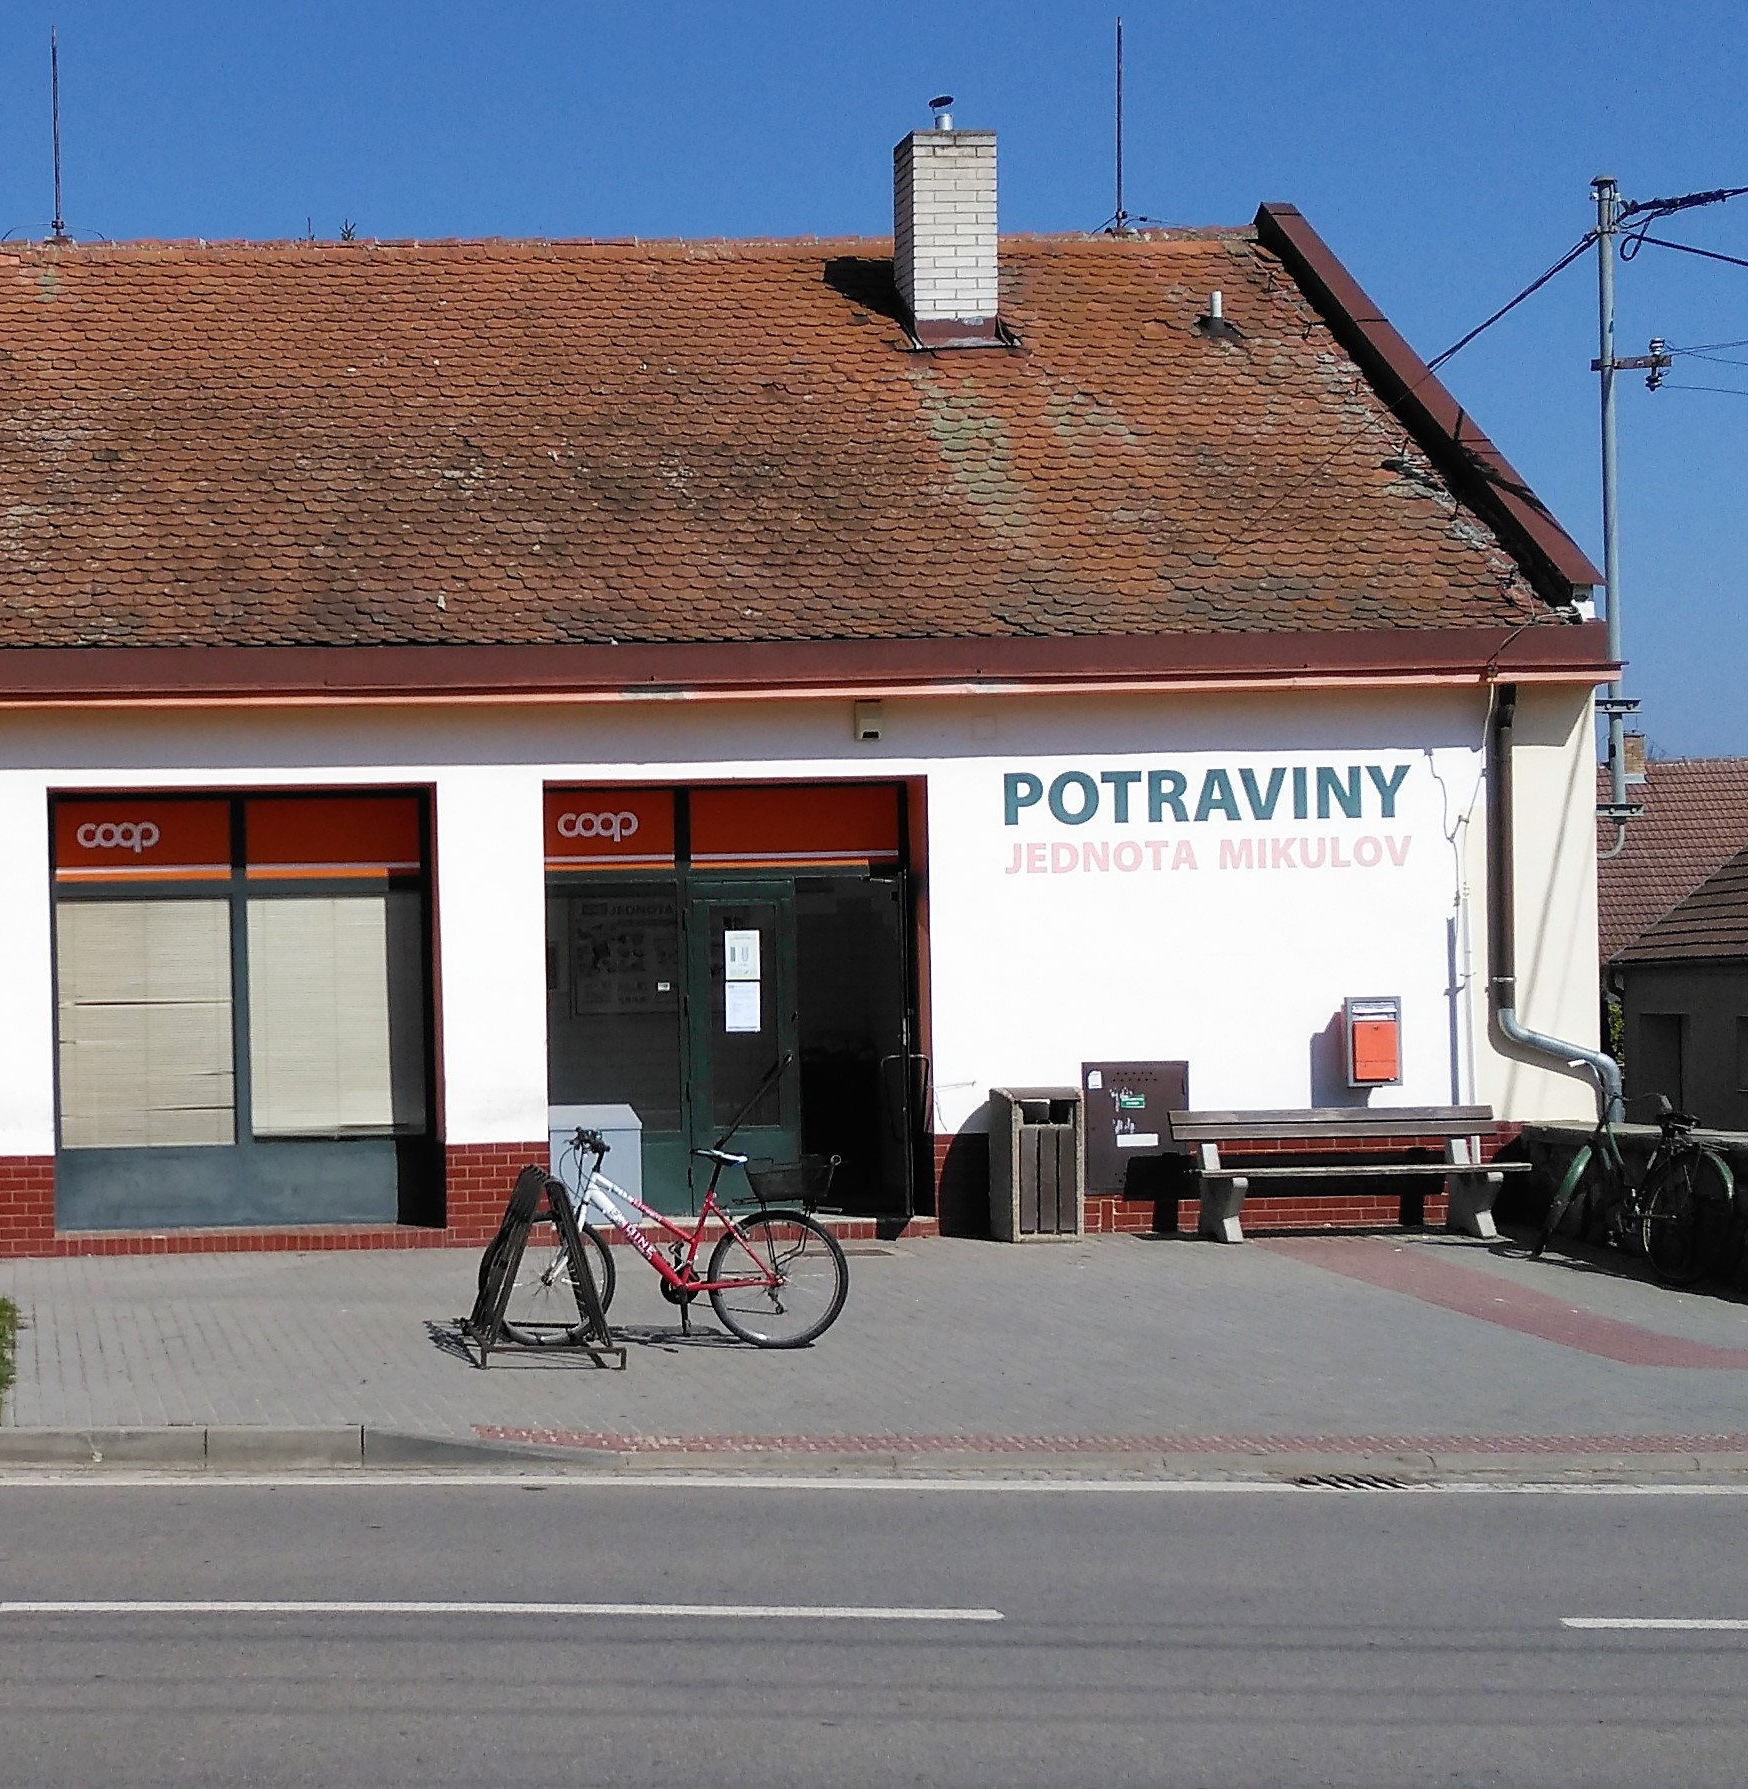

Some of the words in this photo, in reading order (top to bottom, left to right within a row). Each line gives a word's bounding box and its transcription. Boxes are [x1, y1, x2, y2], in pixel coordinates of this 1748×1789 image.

[1004, 765, 1411, 825] POTRAVINY
[77, 823, 159, 852] coop
[558, 812, 638, 841] coop
[1005, 840, 1198, 874] JEDNOTA
[1220, 836, 1411, 869] MIKULOV
